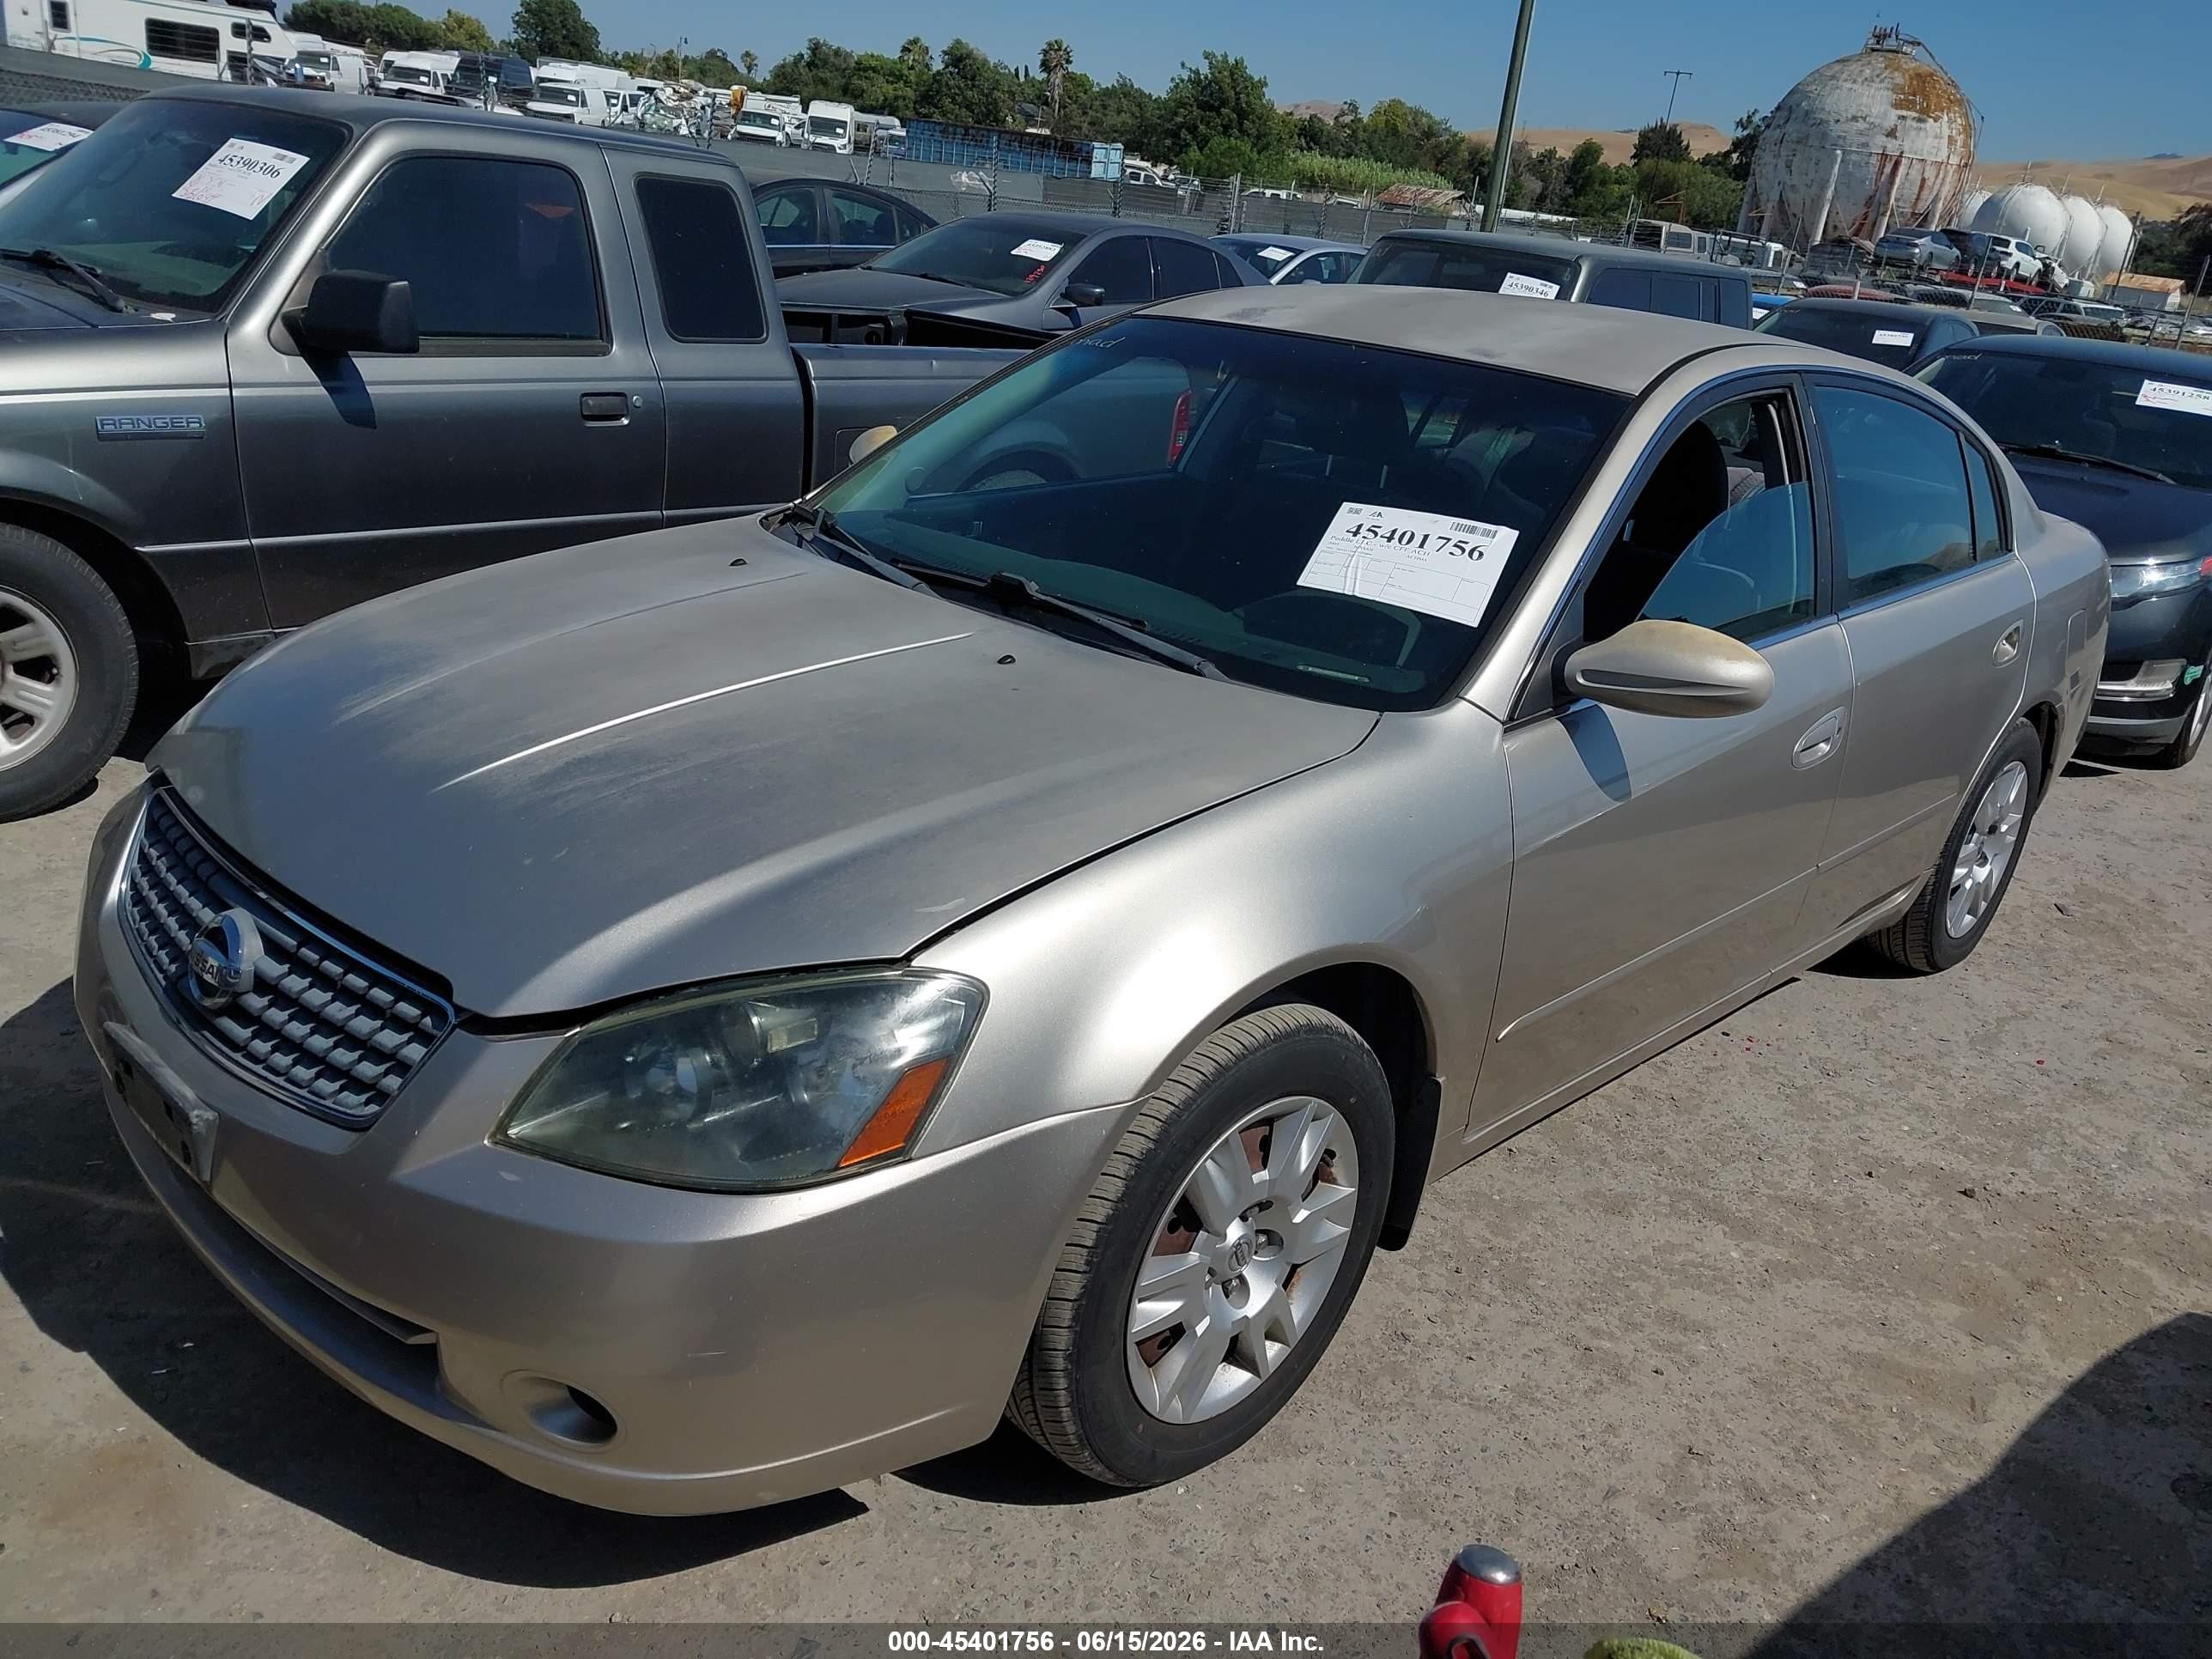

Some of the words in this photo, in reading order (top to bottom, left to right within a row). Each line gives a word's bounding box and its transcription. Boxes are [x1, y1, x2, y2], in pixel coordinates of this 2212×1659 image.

[217, 153, 286, 179] 45390306
[1508, 282, 1550, 297] 45390346
[2149, 386, 2210, 400] 45391258
[97, 416, 205, 430] RANGER
[1345, 522, 1488, 562] 45401756
